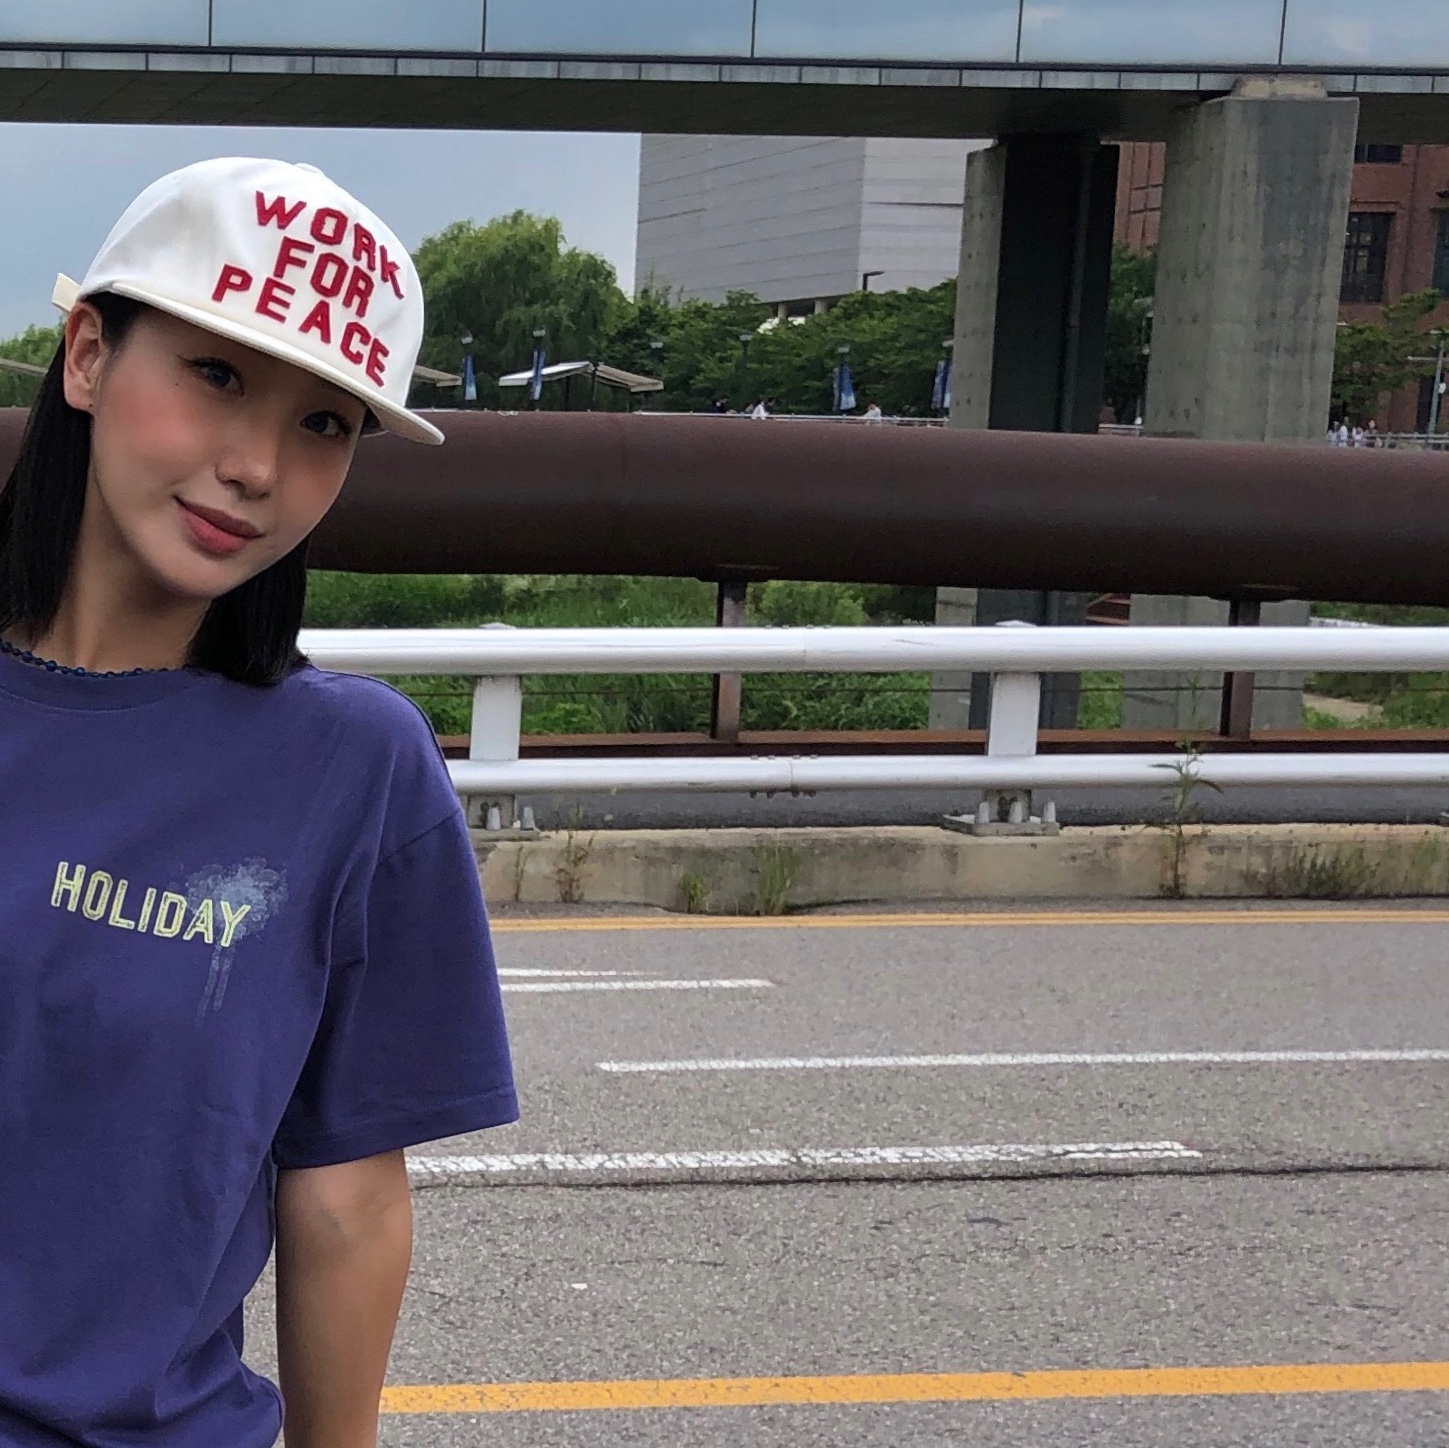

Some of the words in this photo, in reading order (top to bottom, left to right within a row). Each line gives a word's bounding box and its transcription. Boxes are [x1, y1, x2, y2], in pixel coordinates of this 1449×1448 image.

[254, 190, 406, 301] WORK
[273, 236, 376, 319] FOR
[210, 264, 391, 388] PEACE
[50, 861, 252, 948] HOLIDAY
